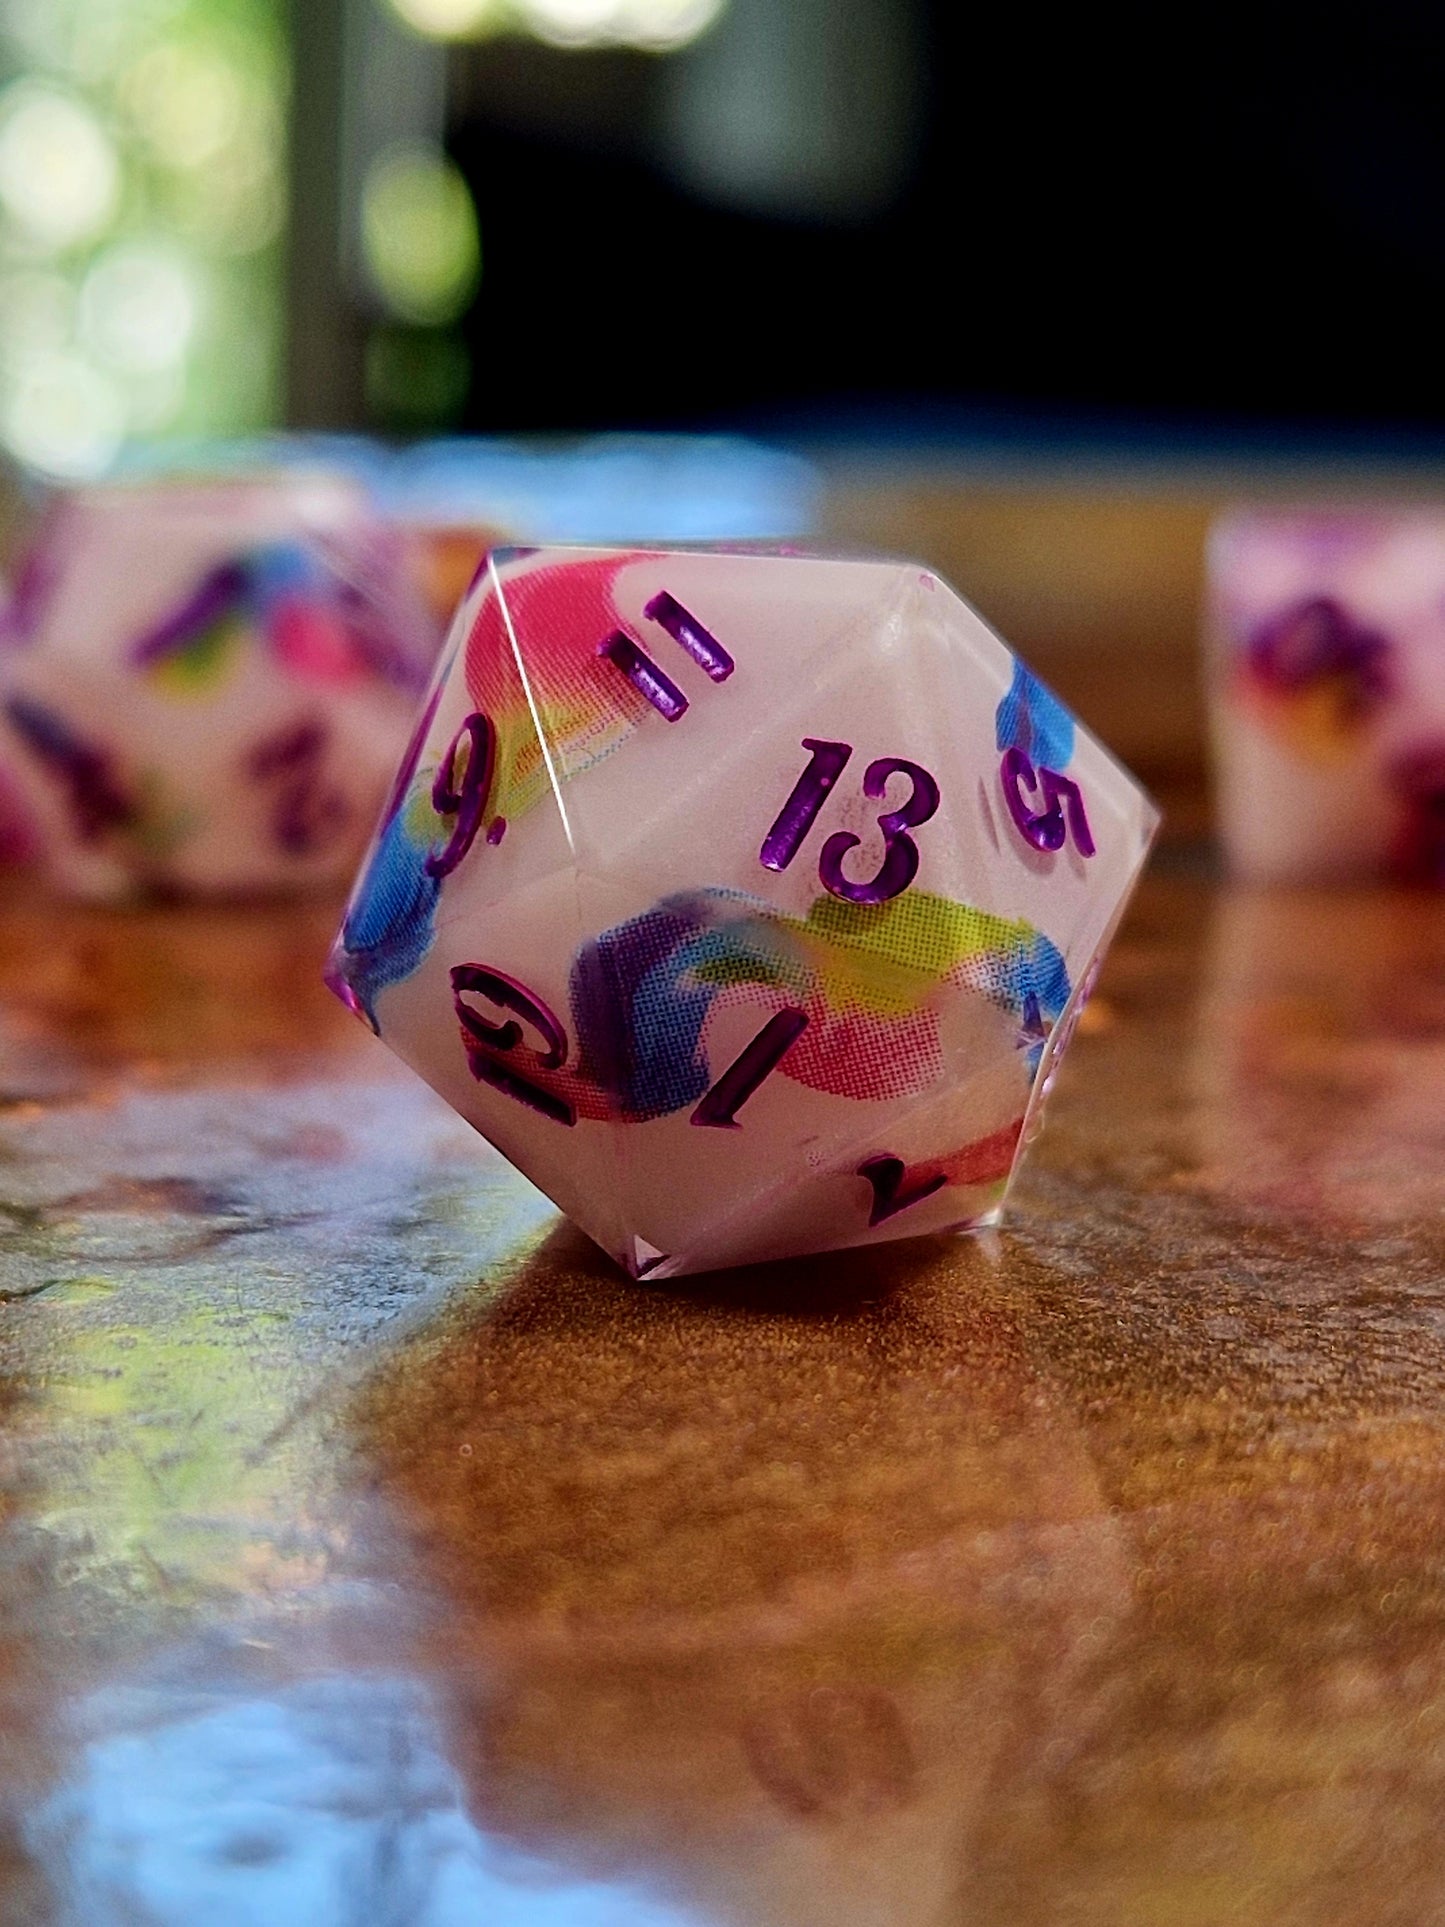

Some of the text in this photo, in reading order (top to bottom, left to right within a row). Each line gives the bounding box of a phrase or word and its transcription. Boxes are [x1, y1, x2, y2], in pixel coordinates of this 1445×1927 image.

[597, 590, 735, 722] 11
[759, 738, 941, 905] 13
[1001, 747, 1096, 858] 5
[449, 962, 577, 1127] 19
[690, 1006, 810, 1129] 1
